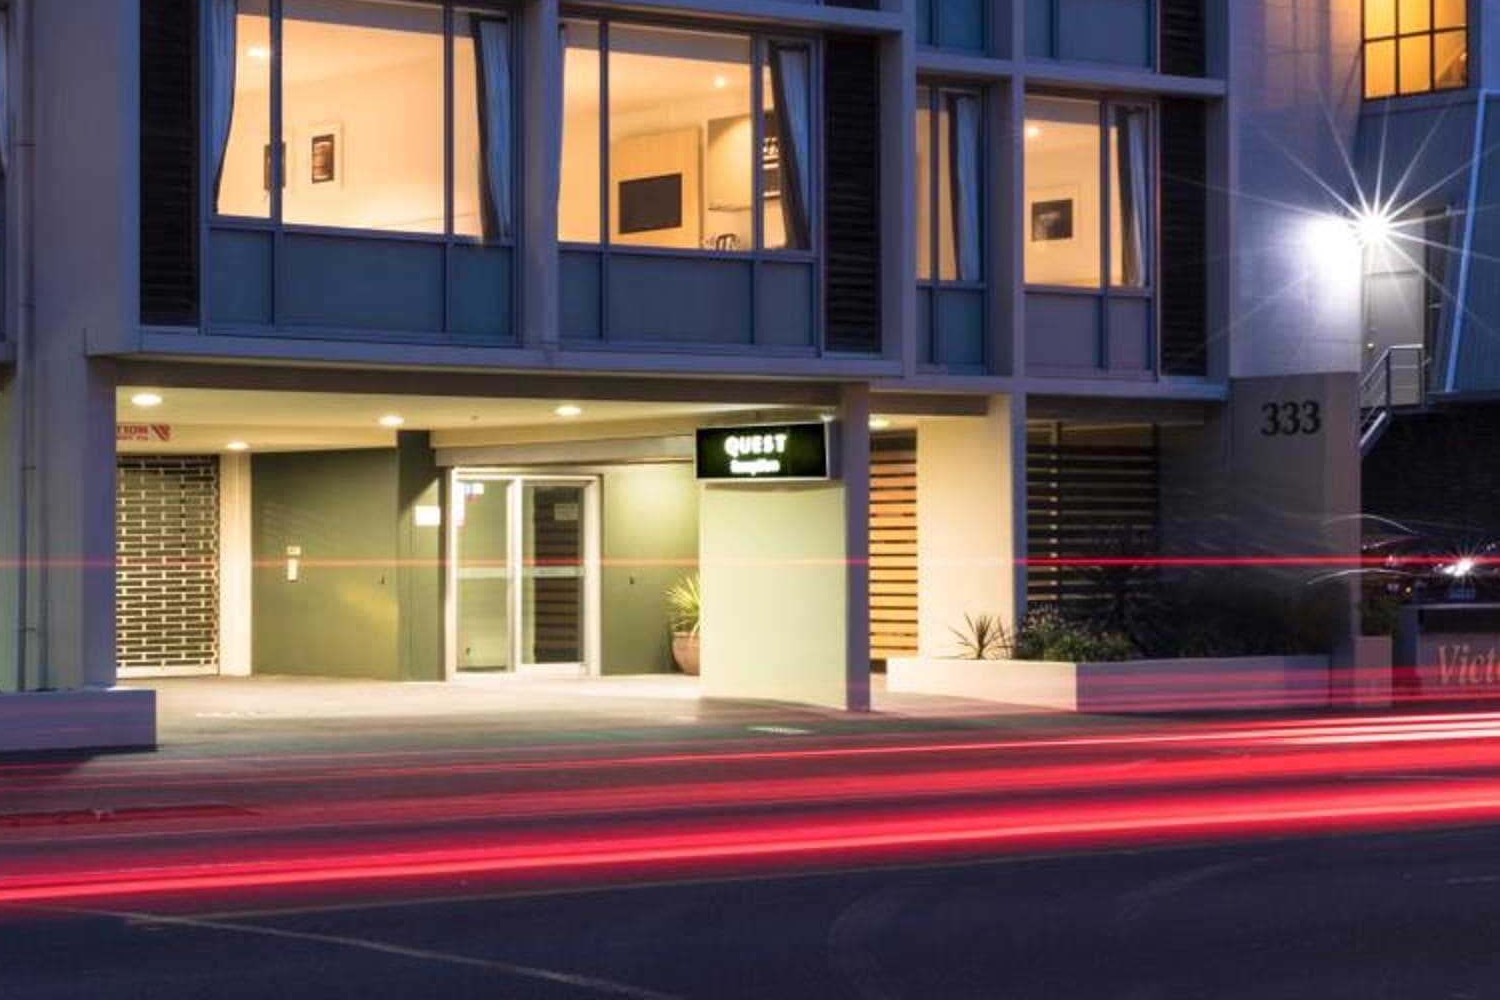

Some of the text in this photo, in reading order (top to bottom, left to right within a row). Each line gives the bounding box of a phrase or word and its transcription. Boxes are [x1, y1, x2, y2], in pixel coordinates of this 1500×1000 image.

[1261, 400, 1321, 436] 333
[724, 433, 787, 457] QUEST
[1438, 644, 1500, 684] Vict
